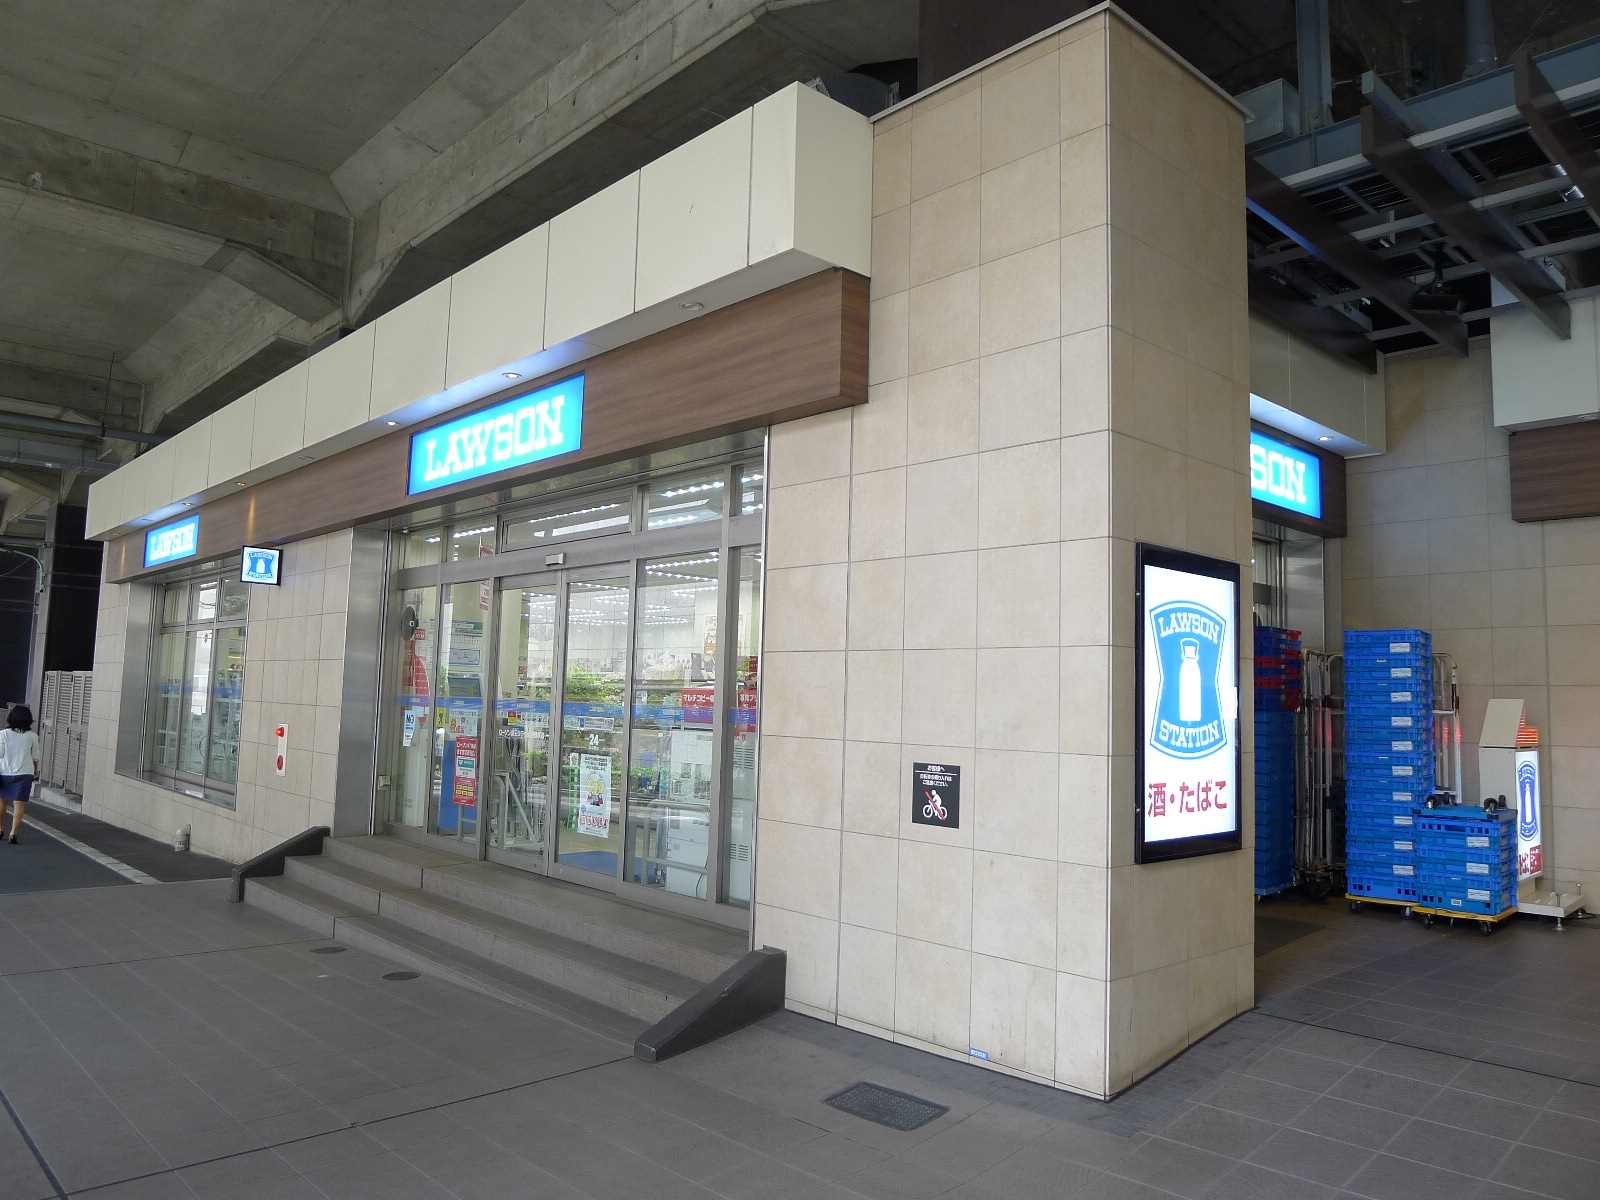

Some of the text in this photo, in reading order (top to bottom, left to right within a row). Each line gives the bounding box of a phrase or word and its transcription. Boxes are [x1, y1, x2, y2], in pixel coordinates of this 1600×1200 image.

[424, 395, 565, 481] LAWSON
[1158, 612, 1219, 644] LAWSON
[1158, 719, 1219, 749] STATION
[1147, 780, 1228, 817] 酒・たばこ
